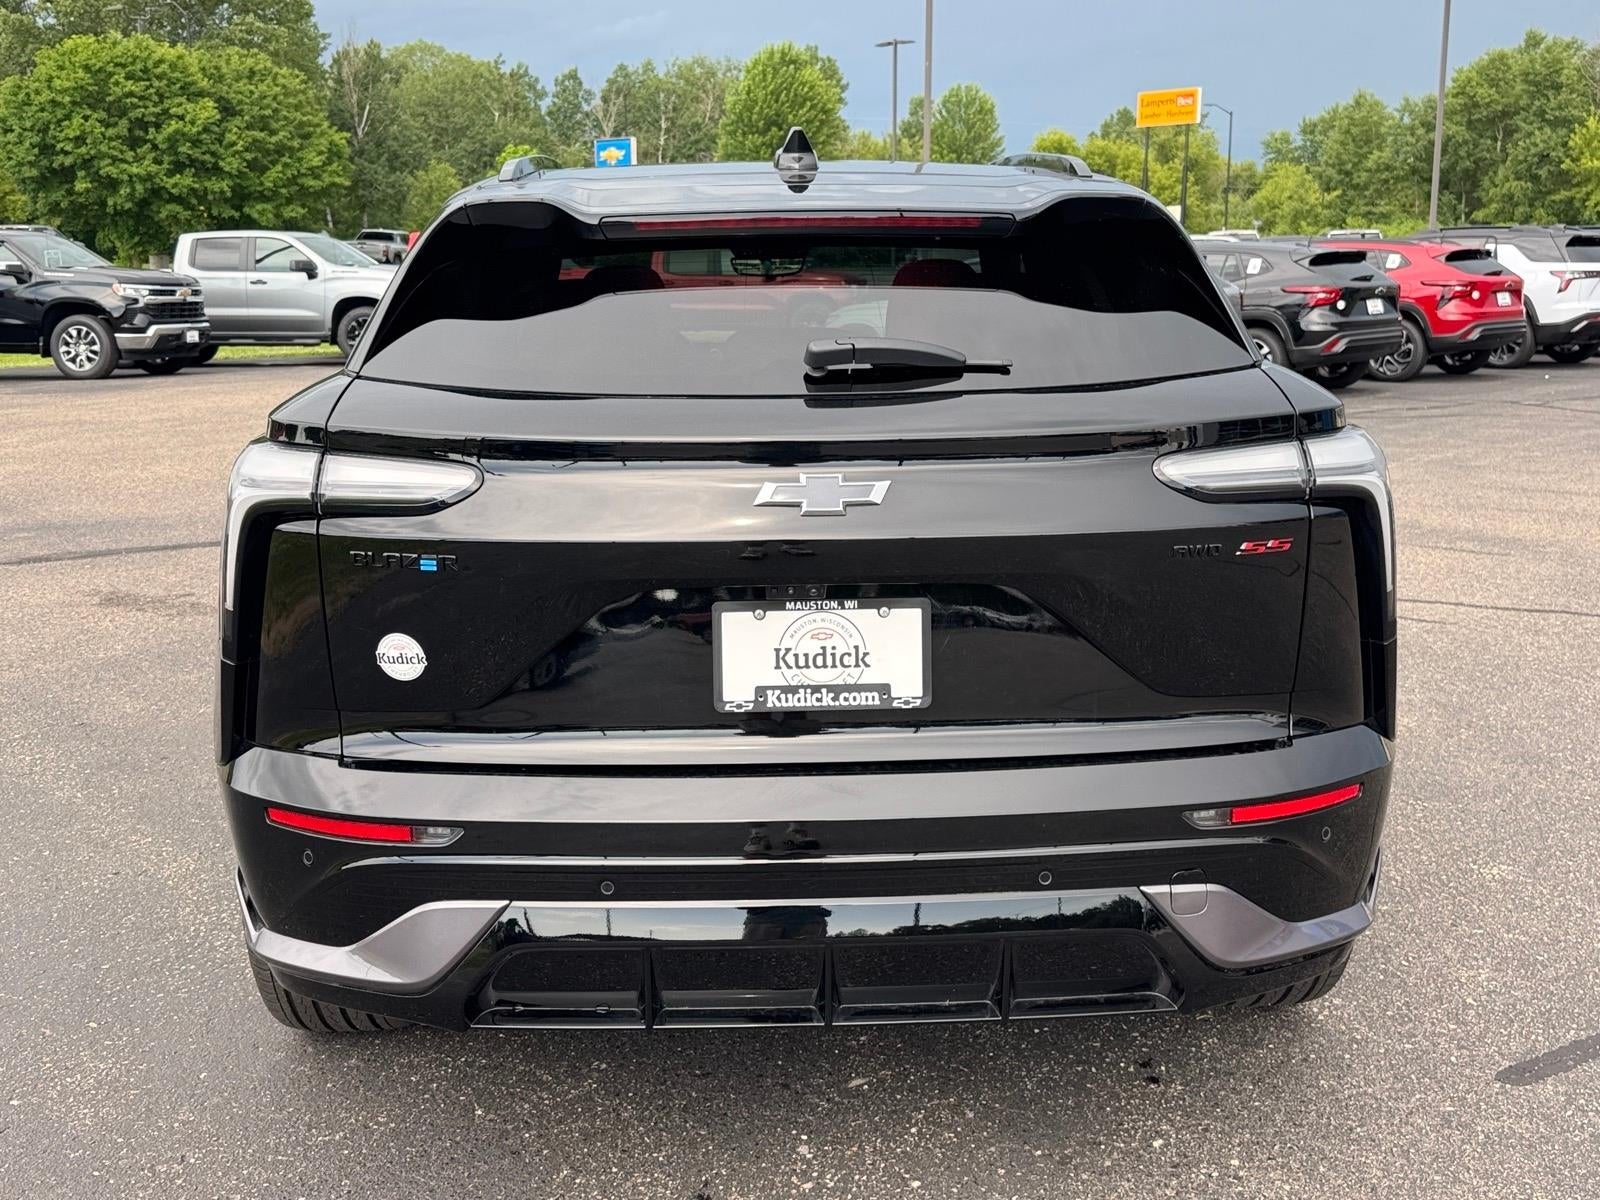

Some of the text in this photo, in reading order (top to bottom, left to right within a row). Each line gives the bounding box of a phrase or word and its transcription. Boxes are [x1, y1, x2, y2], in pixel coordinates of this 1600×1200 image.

[349, 551, 458, 571] BLAZER
[785, 600, 858, 610] MAUSTON, WI
[377, 652, 426, 665] Kudick
[773, 645, 871, 670] Kudick
[766, 688, 880, 708] Kudick.com
